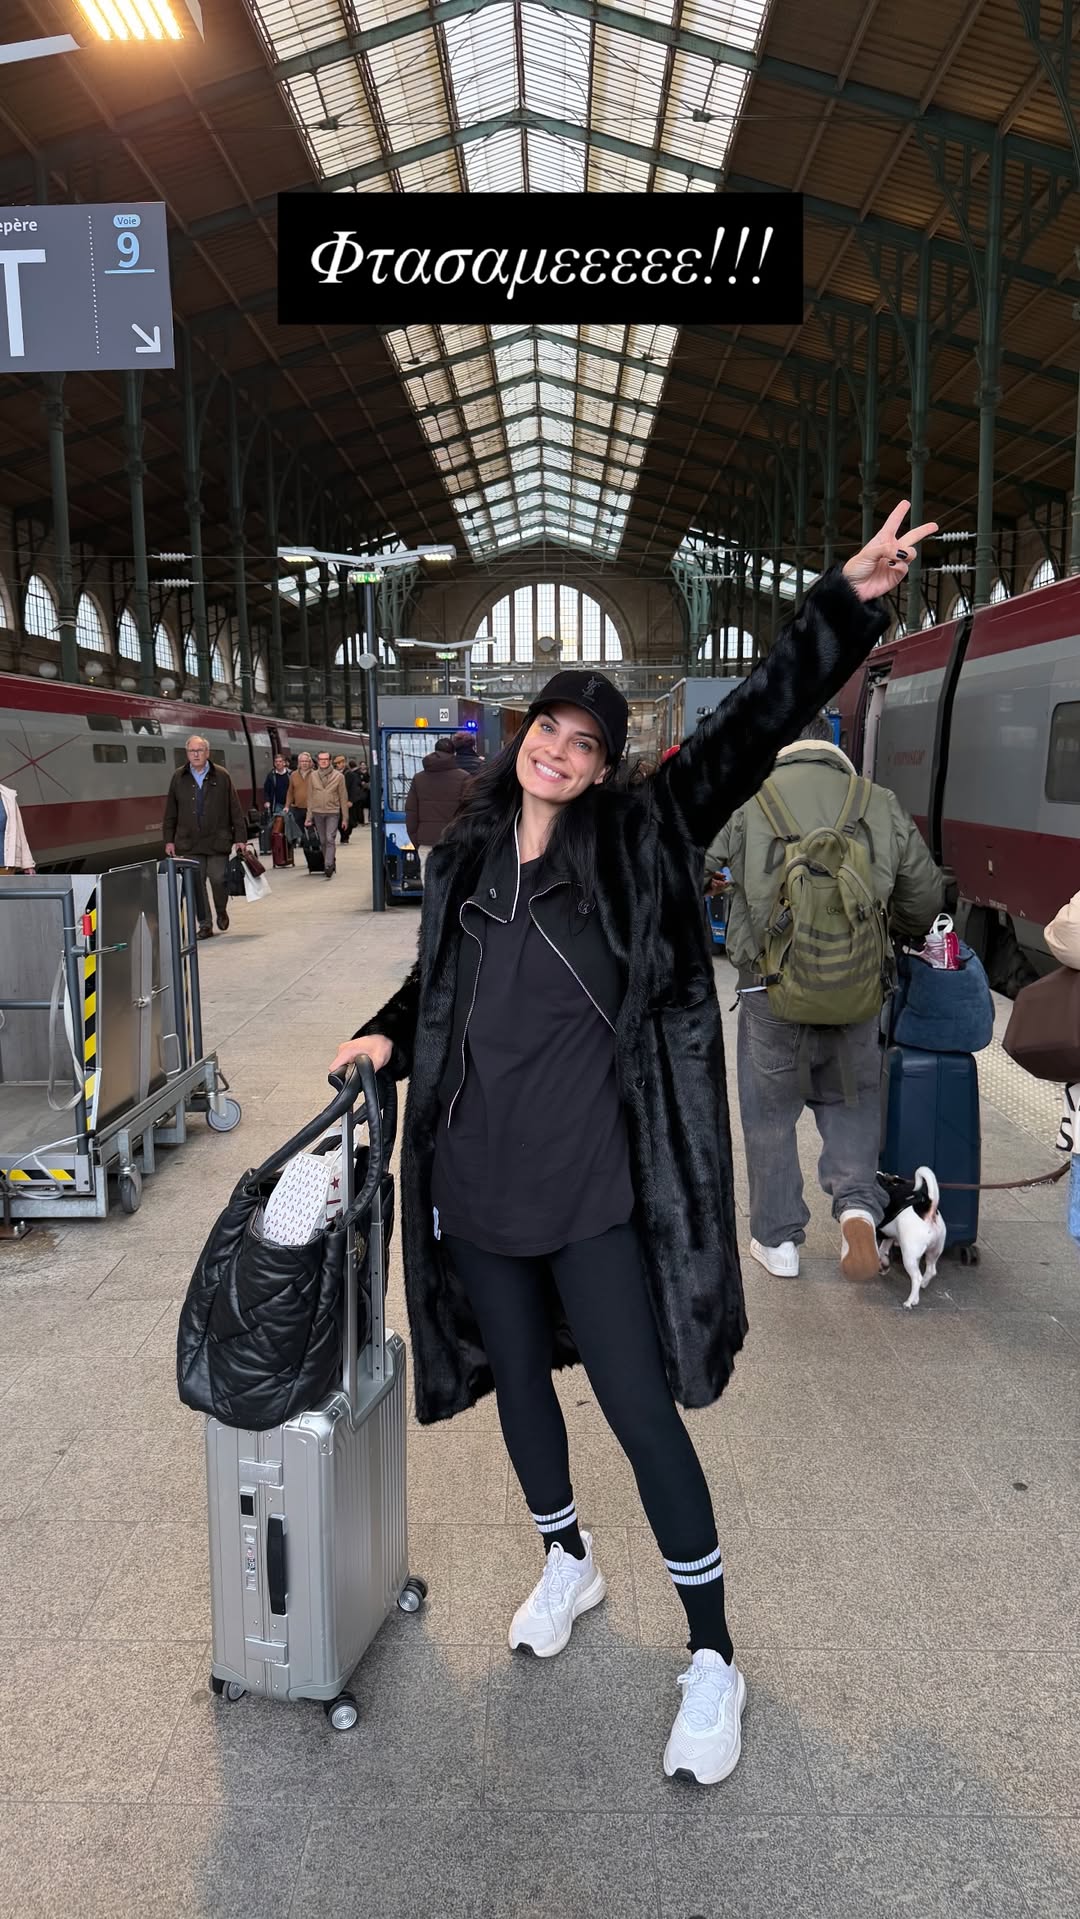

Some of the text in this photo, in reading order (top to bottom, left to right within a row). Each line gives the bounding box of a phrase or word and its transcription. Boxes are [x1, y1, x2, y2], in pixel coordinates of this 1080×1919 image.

[117, 216, 137, 225] Voie
[117, 231, 140, 268] 9
[0, 249, 46, 357] T
